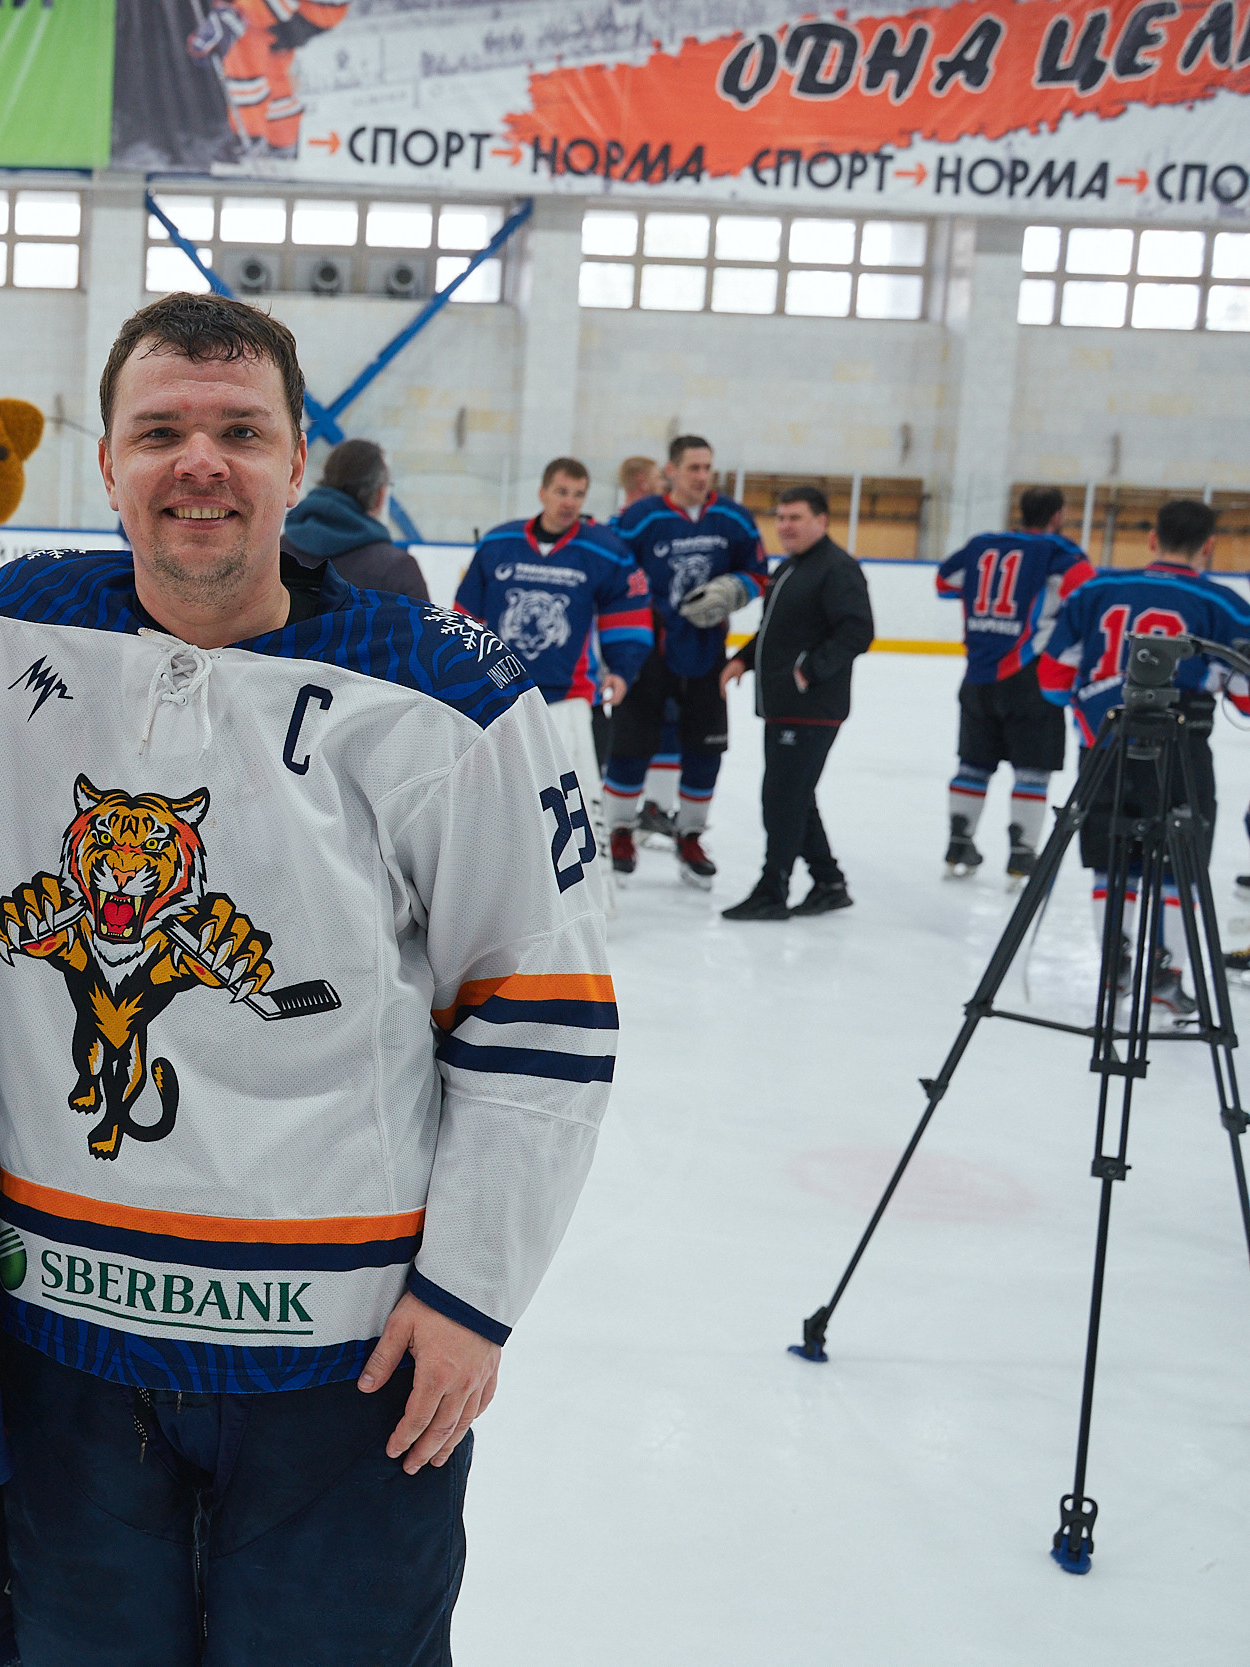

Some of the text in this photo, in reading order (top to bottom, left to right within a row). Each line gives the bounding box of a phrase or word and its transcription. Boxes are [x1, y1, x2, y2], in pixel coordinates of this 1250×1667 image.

[717, 18, 1006, 106] ОДНА
[350, 126, 491, 170] СПОРТ
[533, 138, 707, 184] НОРМА
[751, 149, 894, 193] СПОРТ
[935, 156, 1110, 200] НОРМА
[973, 548, 1023, 619] 11
[283, 684, 333, 775] C
[539, 770, 597, 894] 23
[40, 1249, 314, 1323] SBERBANK
